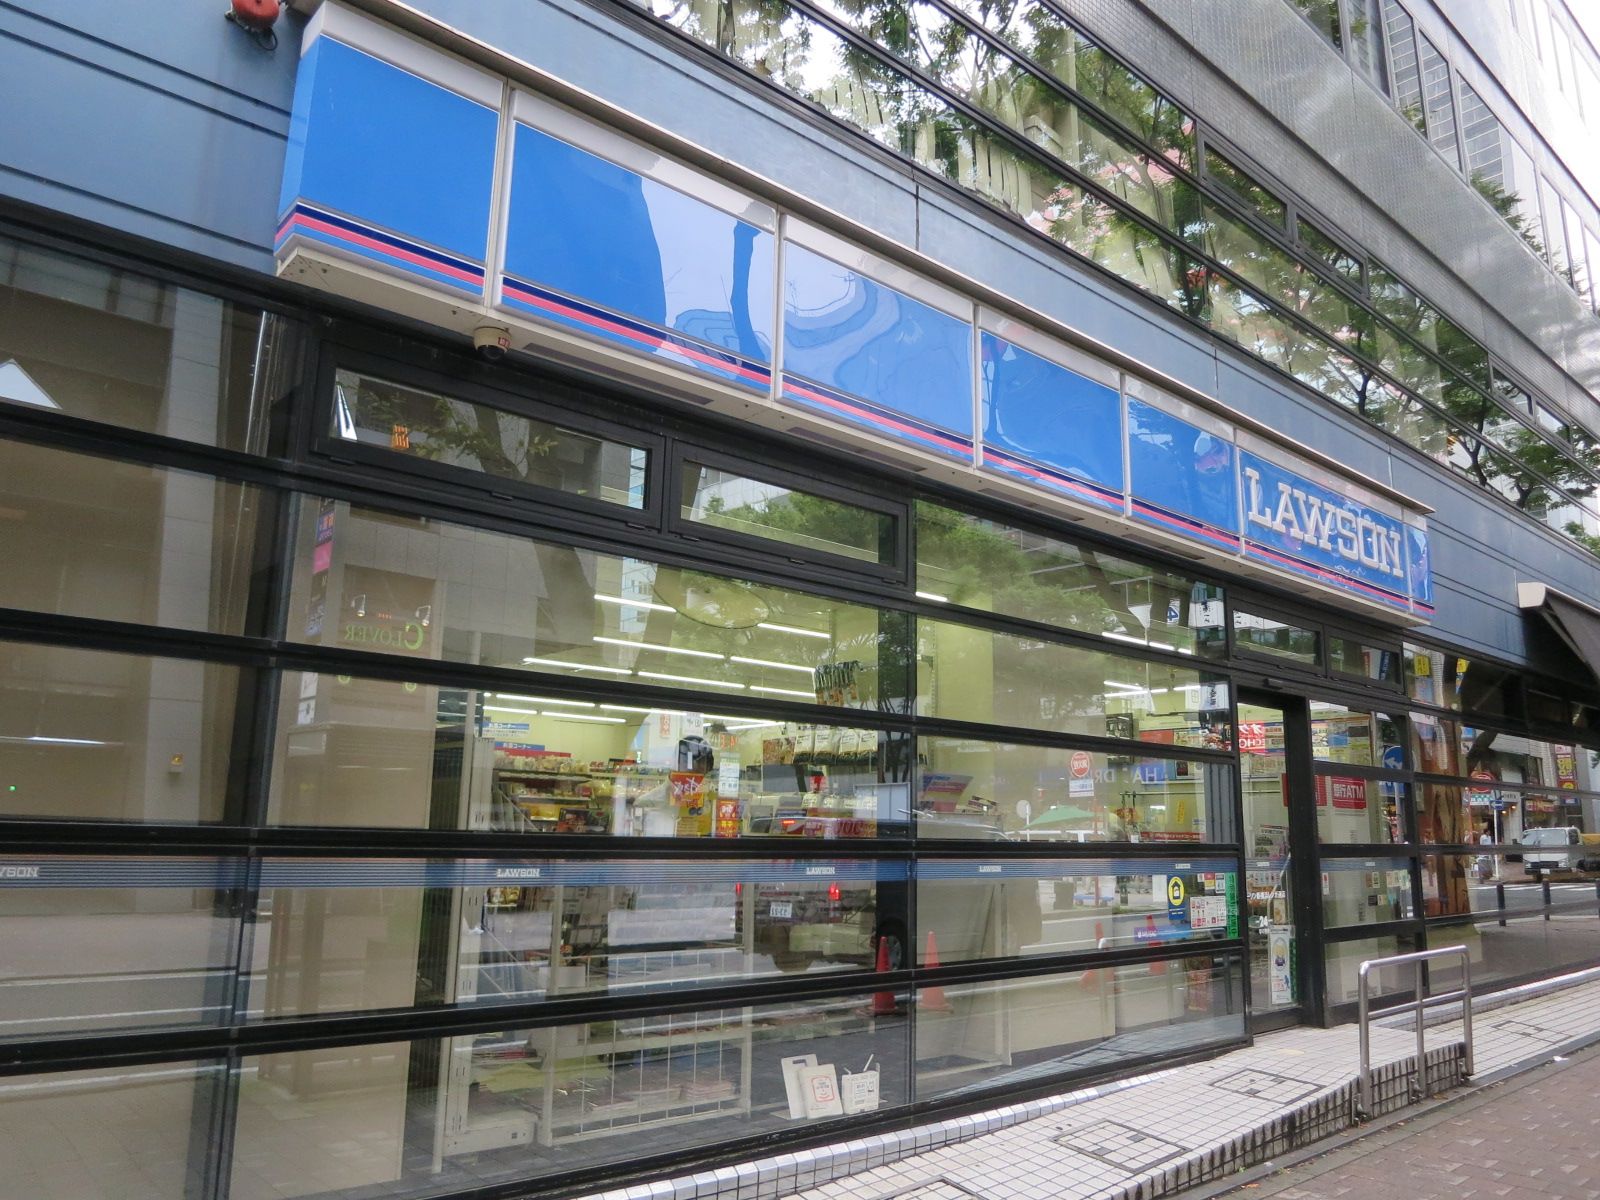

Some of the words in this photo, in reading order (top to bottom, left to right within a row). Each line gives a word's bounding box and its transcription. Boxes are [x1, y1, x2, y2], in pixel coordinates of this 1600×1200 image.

[1245, 467, 1404, 578] LAWSON
[496, 868, 541, 878] LAWSON
[806, 866, 836, 875] LAWSON
